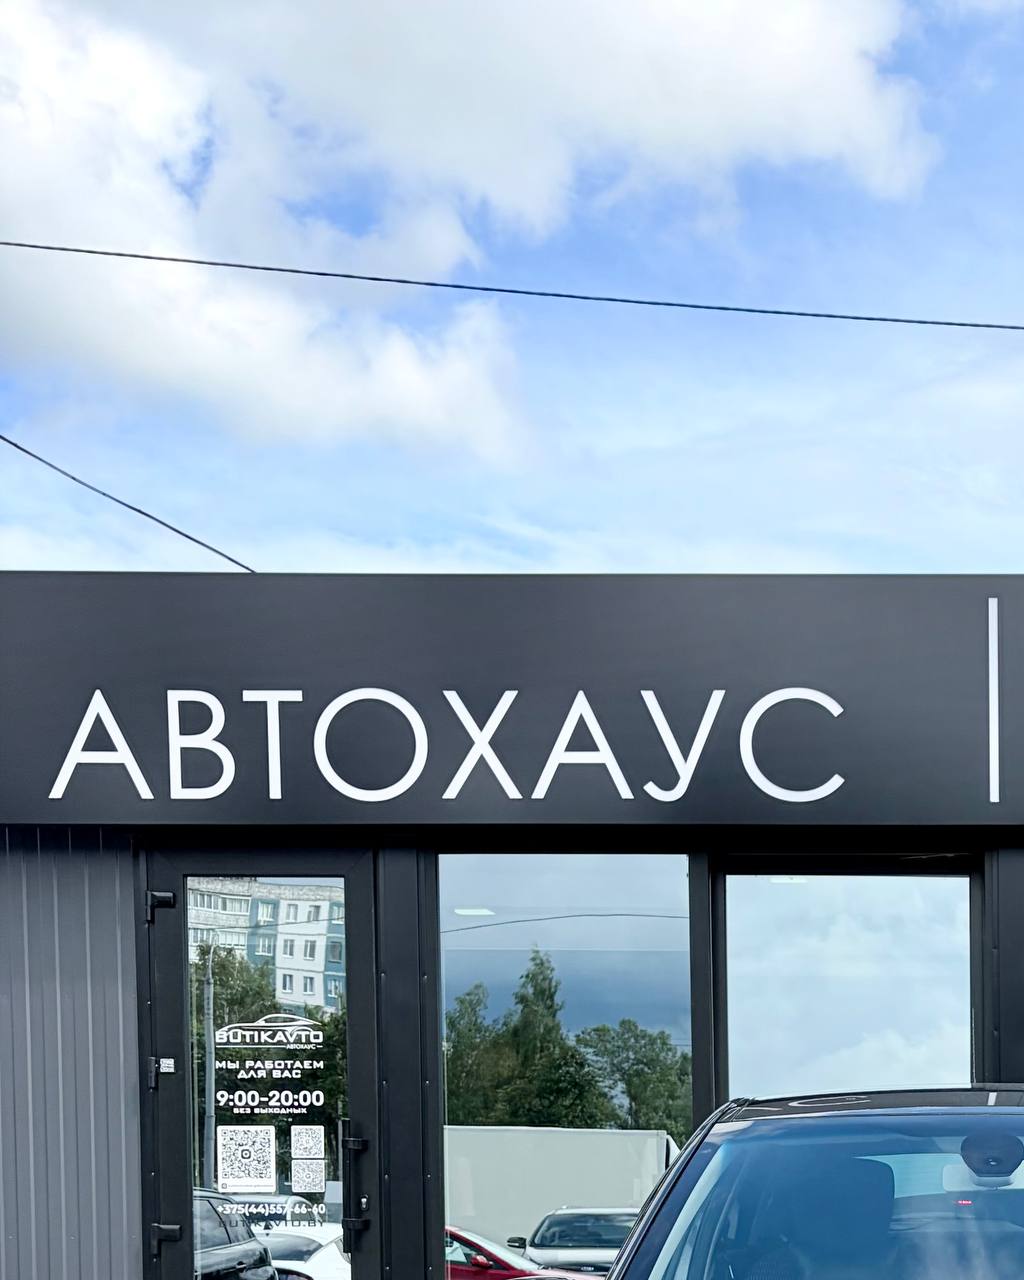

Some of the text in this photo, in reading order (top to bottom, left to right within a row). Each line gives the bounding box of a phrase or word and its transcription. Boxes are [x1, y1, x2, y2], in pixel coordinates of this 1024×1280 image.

[48, 687, 846, 803] АВТОХАУС
[215, 1030, 324, 1043] BUTIKAVTO
[215, 1060, 324, 1069] МЫ РАБОТАЕМ
[237, 1069, 302, 1079] ДЛЯ ВАС
[216, 1090, 325, 1107] 9:00-20:00
